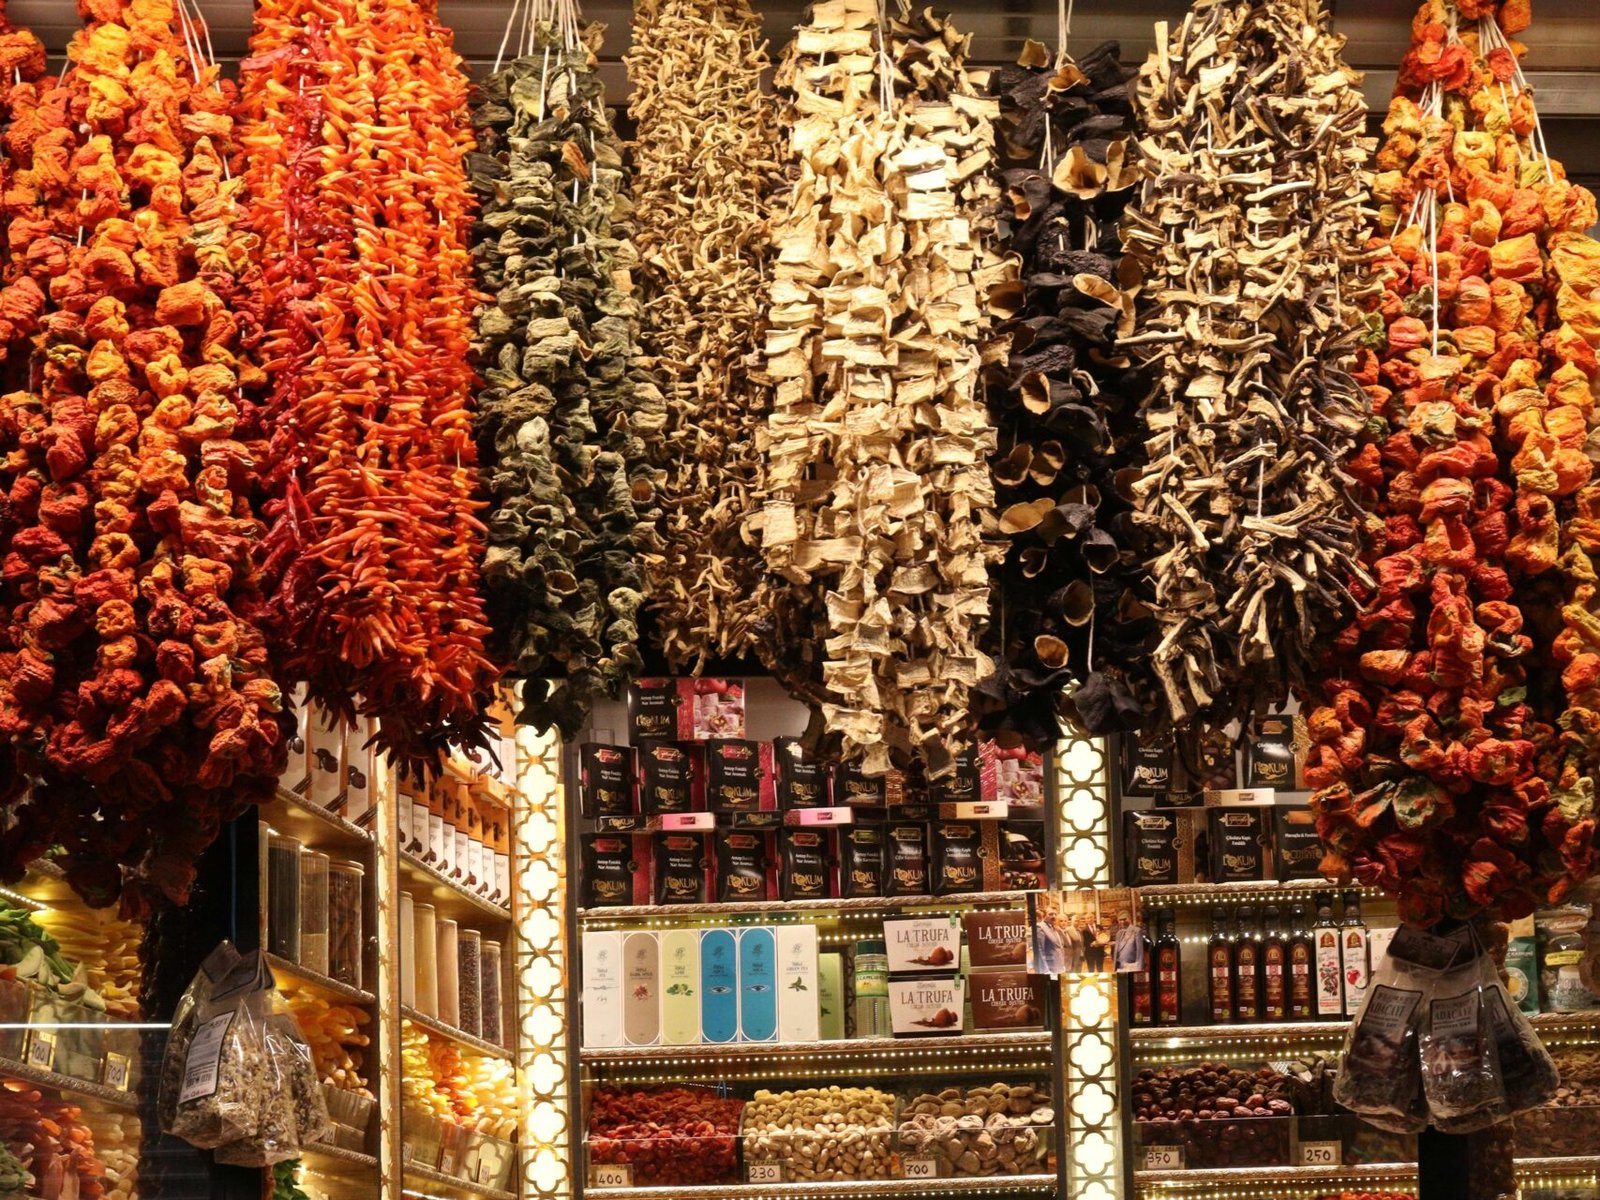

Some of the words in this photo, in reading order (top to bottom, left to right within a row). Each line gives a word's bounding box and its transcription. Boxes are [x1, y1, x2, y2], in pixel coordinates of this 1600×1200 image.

[897, 930, 910, 943] LA
[913, 928, 949, 942] TRUFA
[979, 926, 992, 940] LA
[994, 924, 1027, 938] TRUF
[901, 992, 914, 1005] LA
[917, 990, 953, 1004] TRUFA
[982, 989, 995, 1002] LA
[997, 987, 1034, 1001] TRUFA
[1147, 1152, 1170, 1164] 350
[1306, 1149, 1331, 1161] 250
[750, 1167, 775, 1178] 230
[906, 1164, 928, 1174] 700
[599, 1174, 622, 1184] 400
